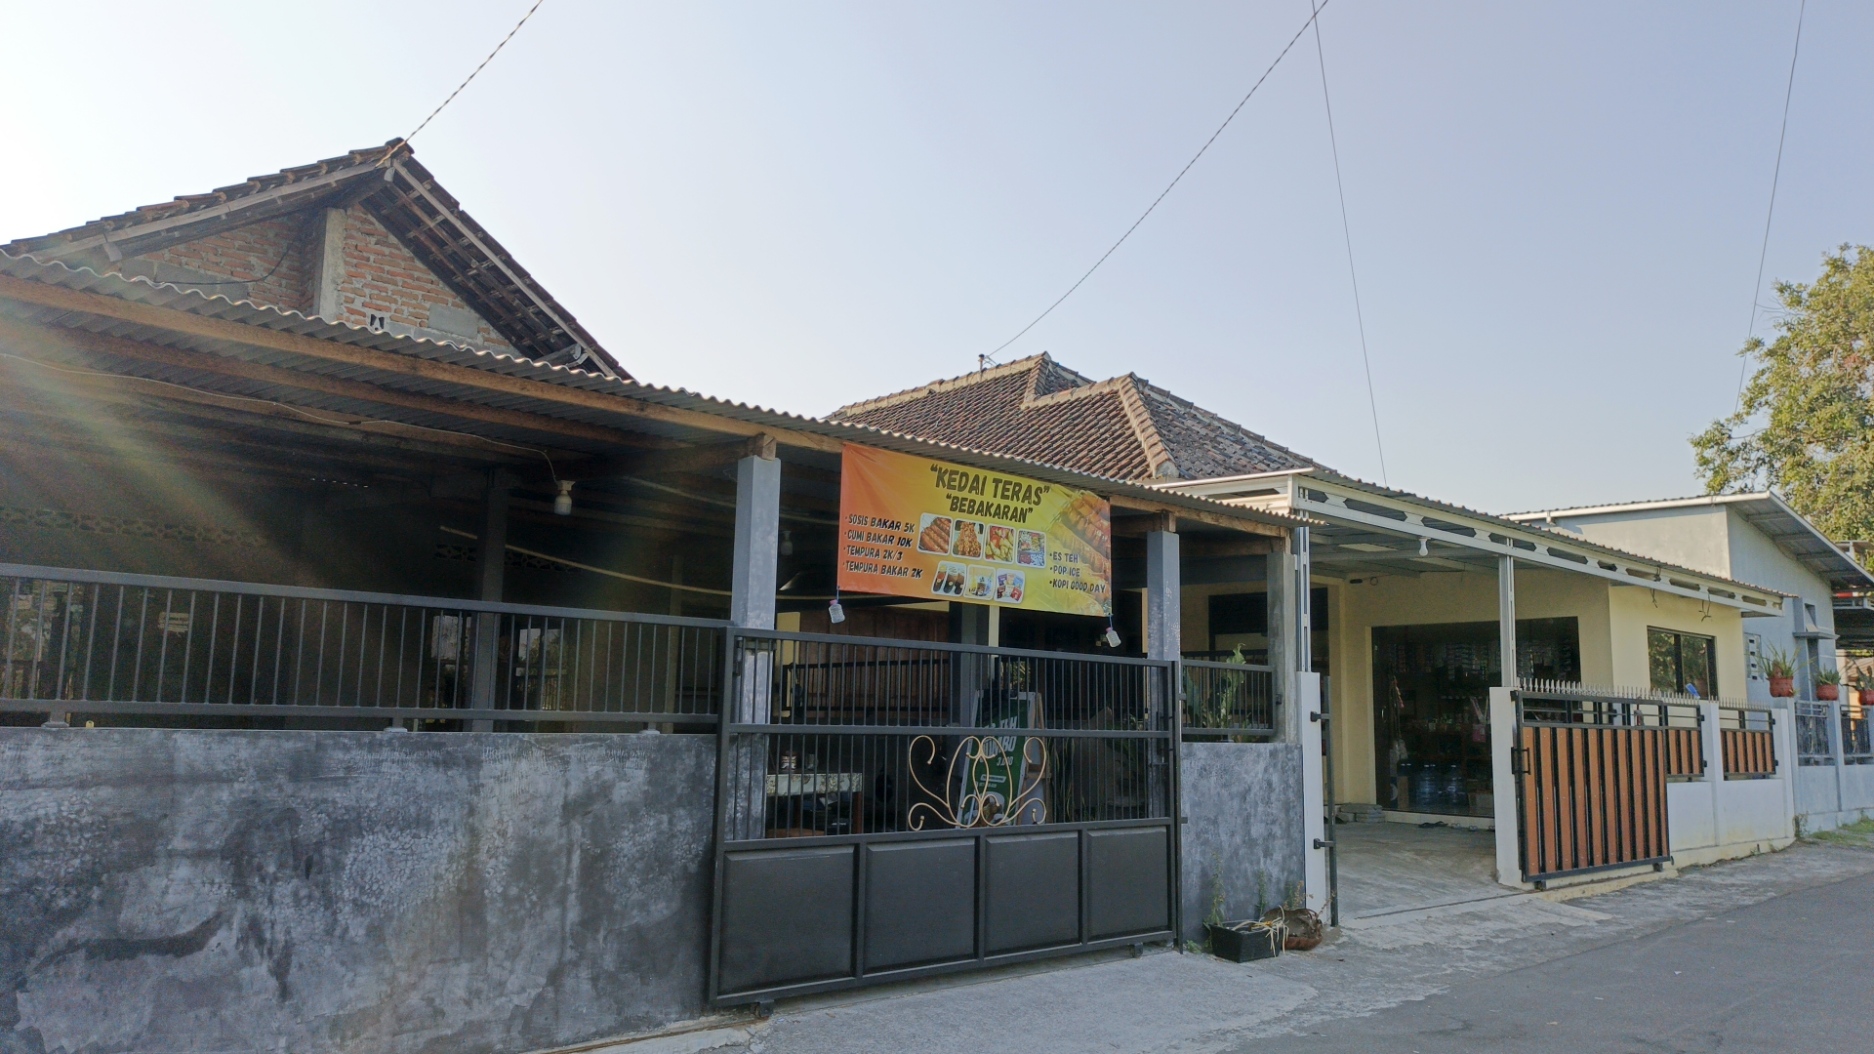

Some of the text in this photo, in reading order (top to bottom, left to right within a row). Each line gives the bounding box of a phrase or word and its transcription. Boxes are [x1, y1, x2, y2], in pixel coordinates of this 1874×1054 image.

[848, 513, 916, 533] SOSIS BAKAR 5K
[847, 529, 913, 548] CUMI BAKAR 10K
[846, 545, 903, 561] TEMPURA 2K/3
[1052, 551, 1079, 563] ES TEH
[845, 560, 923, 579] TEMPURA BAKAR 2K
[1053, 565, 1080, 577] POP ICE
[1052, 578, 1106, 594] KOPI GOOD DAY
